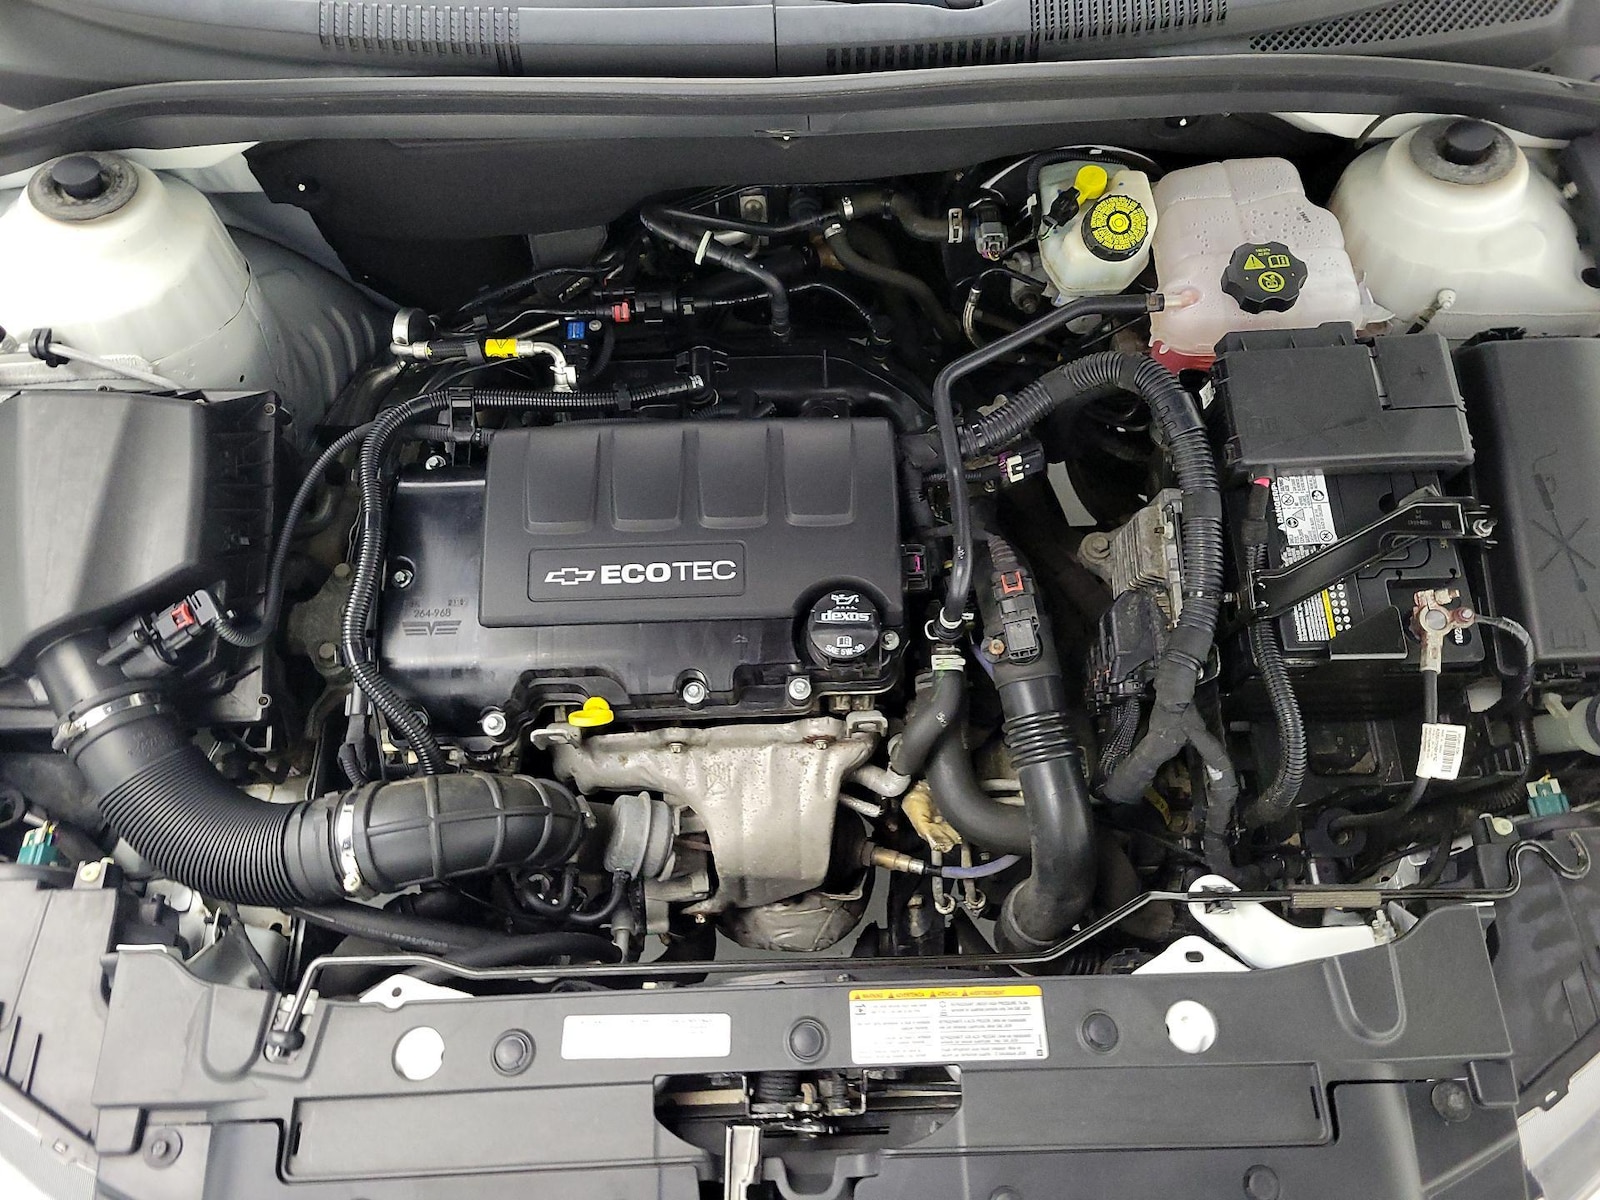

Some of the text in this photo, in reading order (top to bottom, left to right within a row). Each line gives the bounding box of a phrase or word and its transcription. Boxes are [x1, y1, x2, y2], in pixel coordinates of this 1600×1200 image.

[600, 560, 737, 585] ECOTEC
[821, 610, 872, 622] dexos
[825, 643, 866, 656] SAE 5W-30
